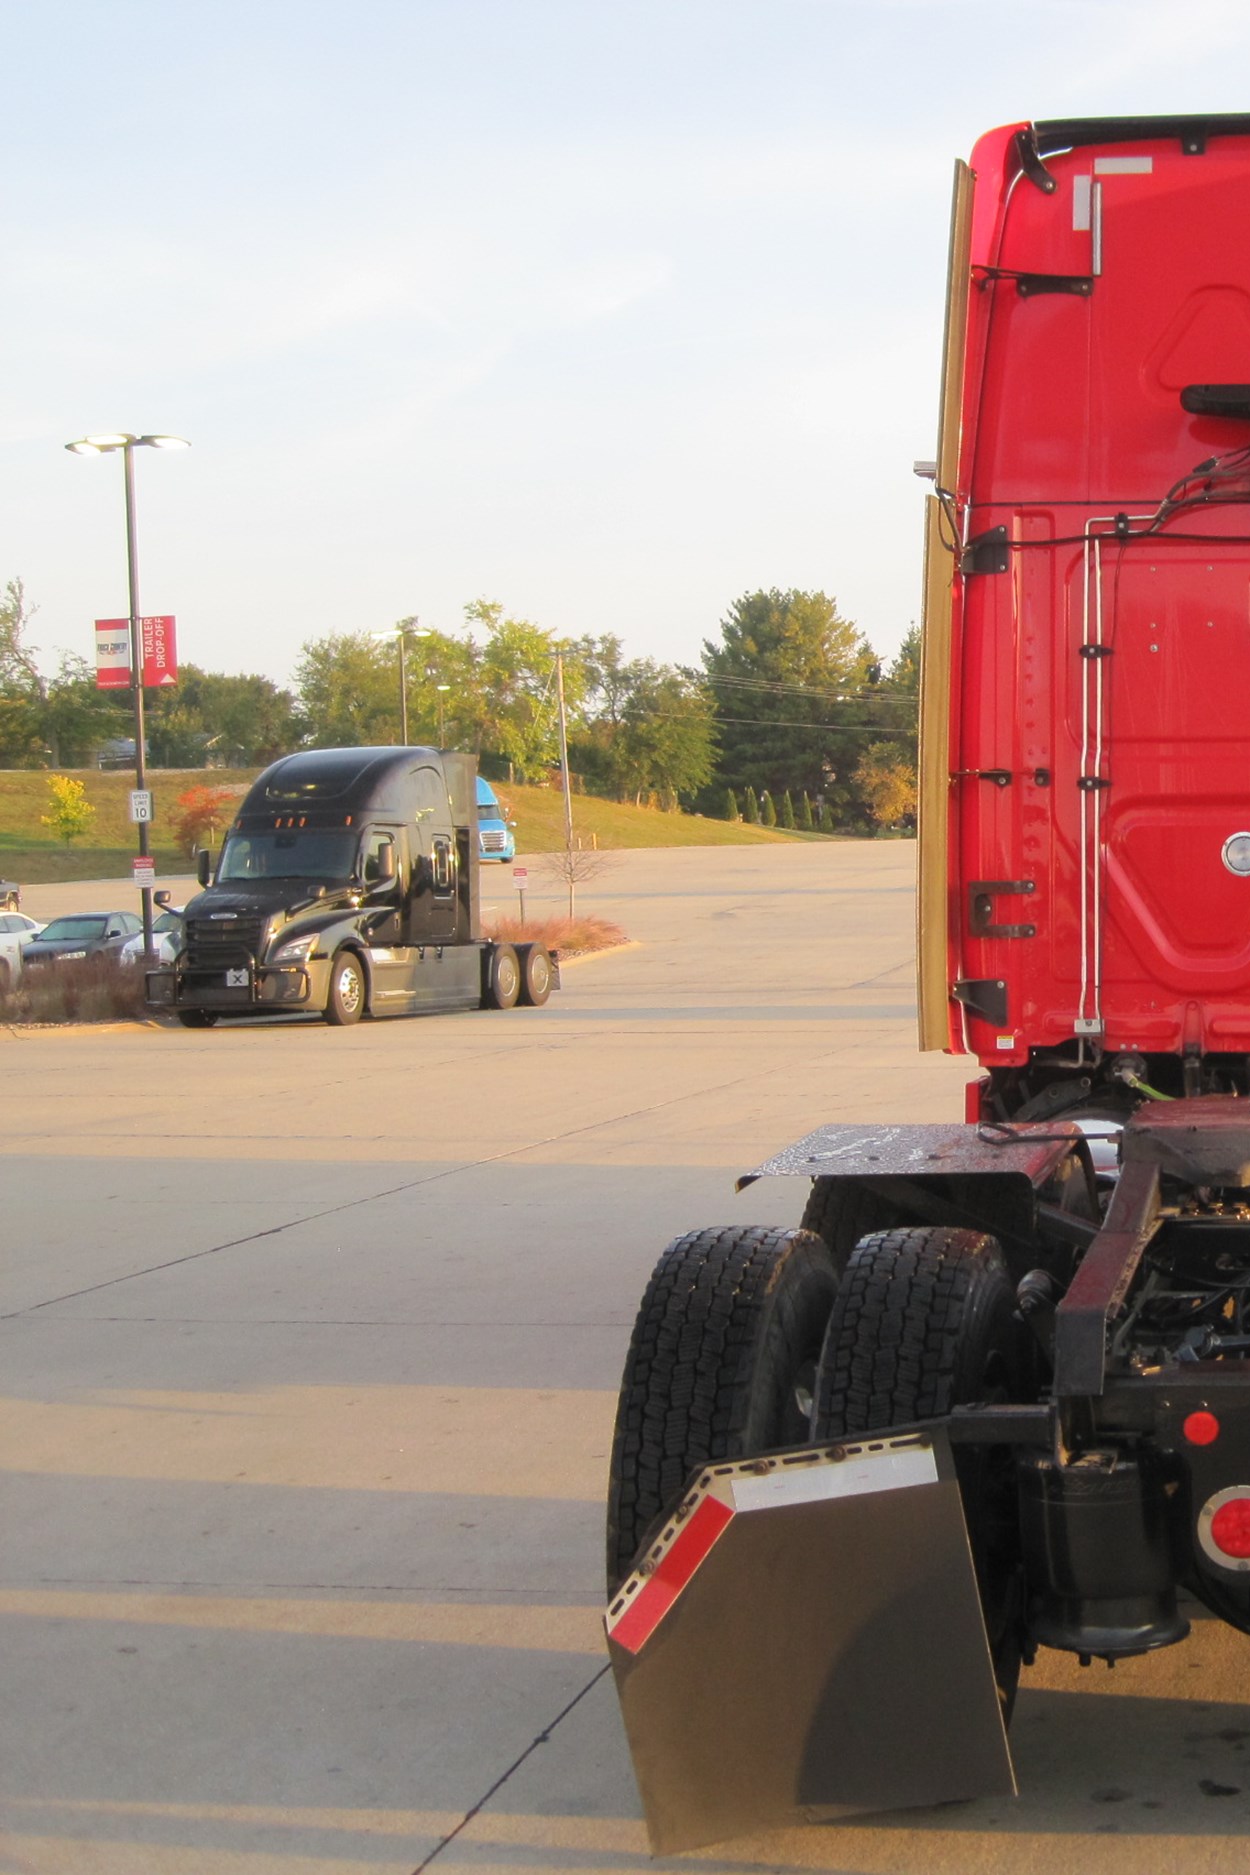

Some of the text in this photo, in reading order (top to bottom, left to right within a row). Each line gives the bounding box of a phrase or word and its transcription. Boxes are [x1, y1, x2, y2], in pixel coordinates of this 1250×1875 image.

[144, 618, 155, 659] TRAILER
[155, 617, 166, 668] DROP-OFF
[136, 808, 147, 818] 10
[232, 974, 243, 984] X
